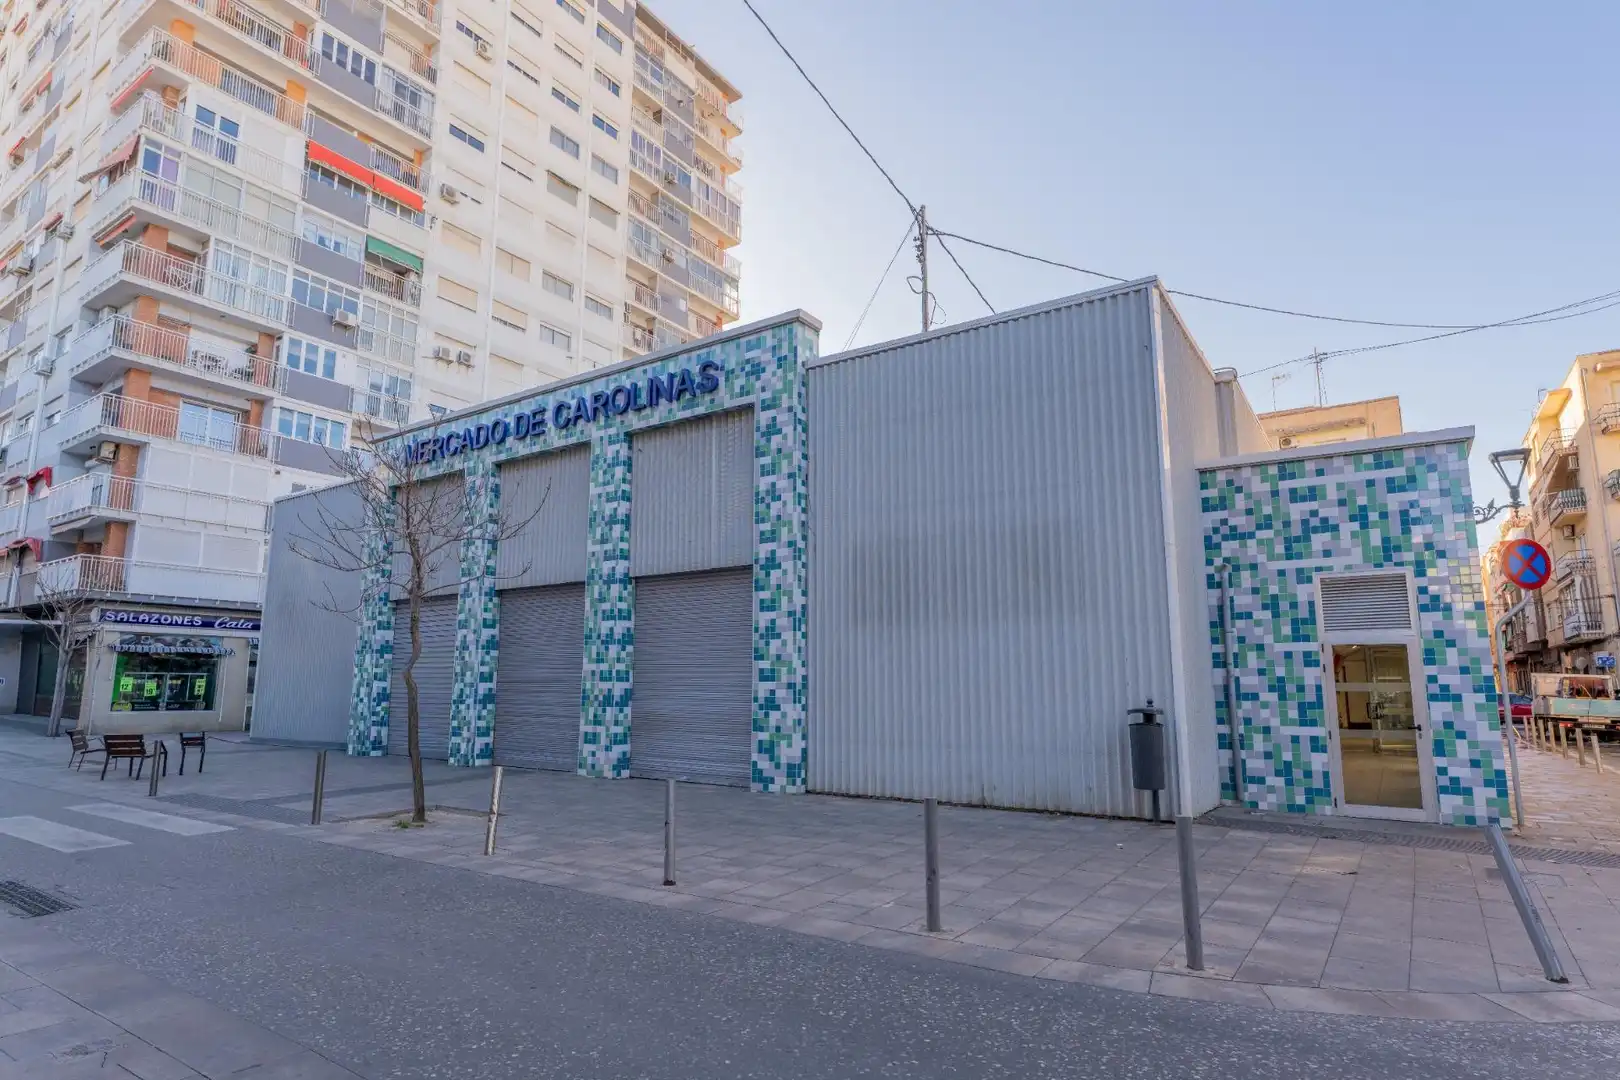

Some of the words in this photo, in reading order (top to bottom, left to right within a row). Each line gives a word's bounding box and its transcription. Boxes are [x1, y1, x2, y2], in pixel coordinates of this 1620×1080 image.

[405, 418, 508, 466] MERCADO
[513, 407, 546, 440] DE
[552, 360, 720, 429] CAROLINAS
[105, 610, 202, 626] SALAZONES
[214, 616, 253, 629] Cala
